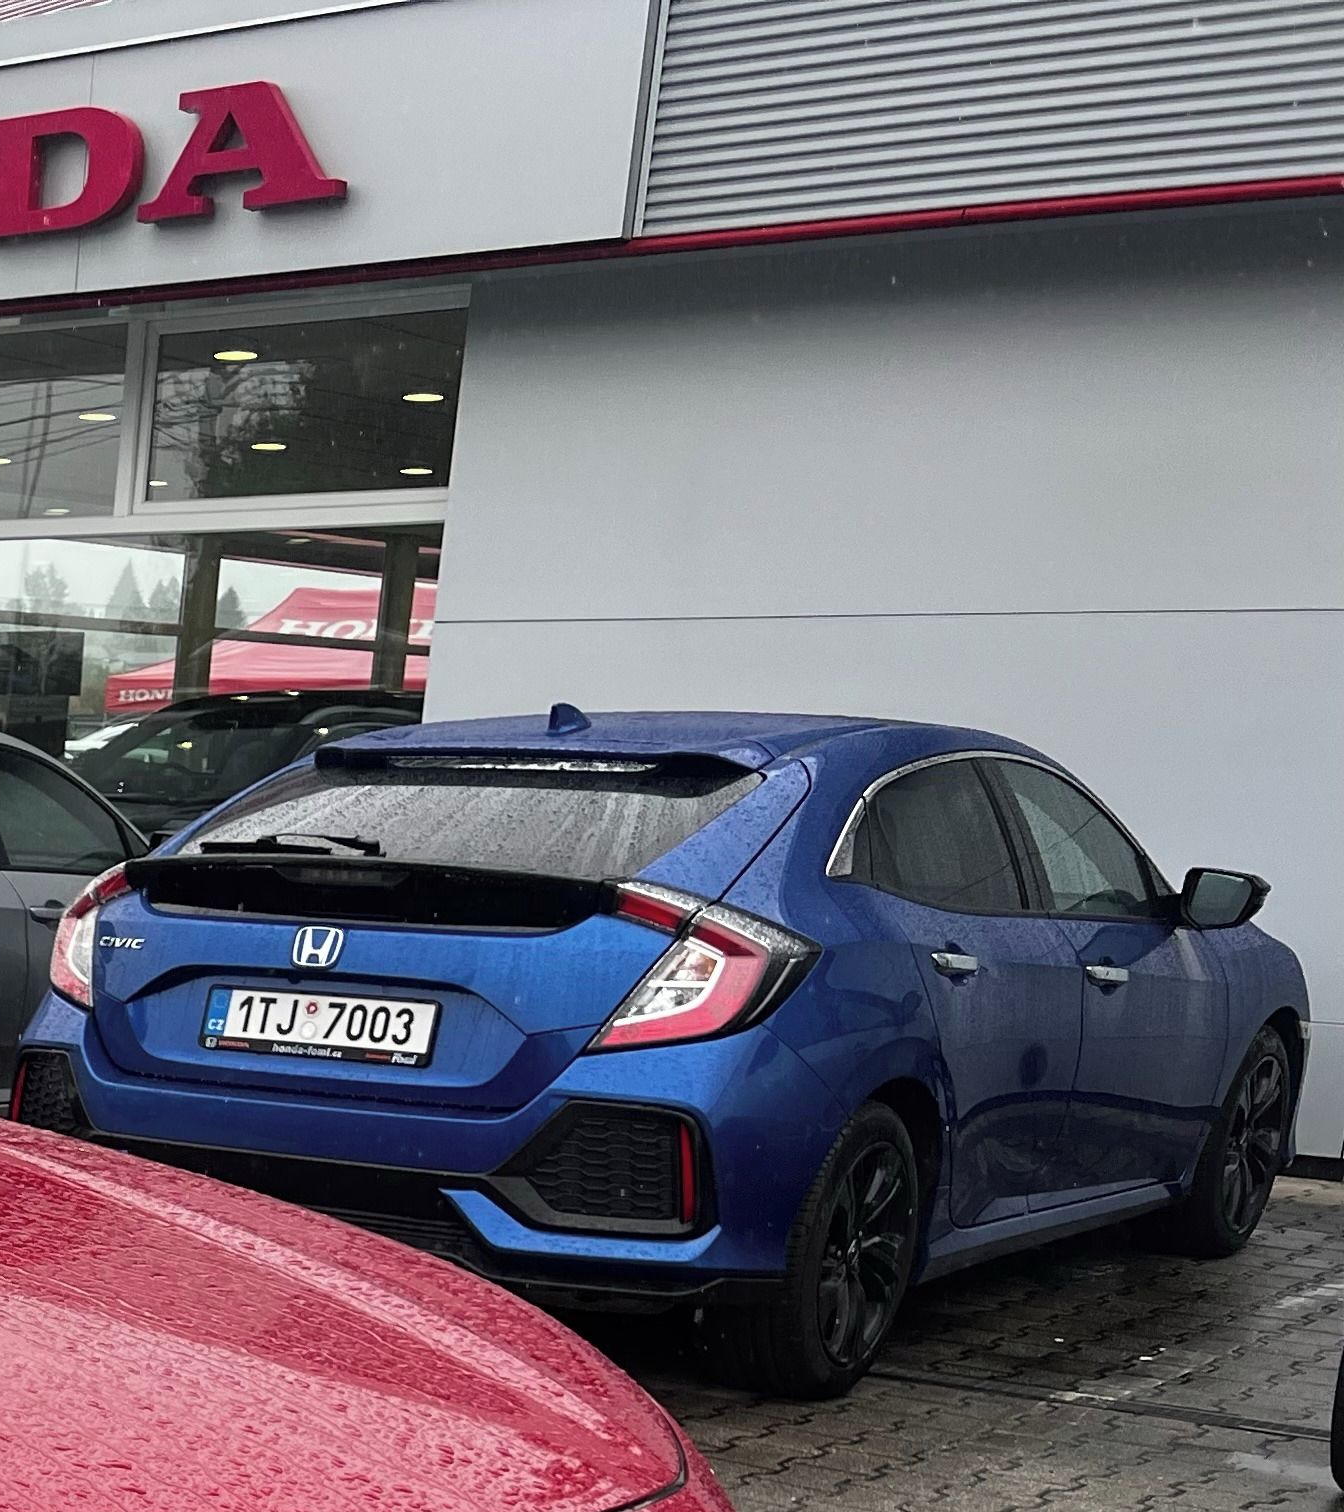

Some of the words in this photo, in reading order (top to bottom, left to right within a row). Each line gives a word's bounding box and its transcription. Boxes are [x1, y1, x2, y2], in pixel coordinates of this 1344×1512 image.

[99, 935, 145, 949] CIVIC
[207, 1018, 224, 1031] CZ
[239, 996, 300, 1036] 1TJ
[322, 1002, 414, 1045] 7003
